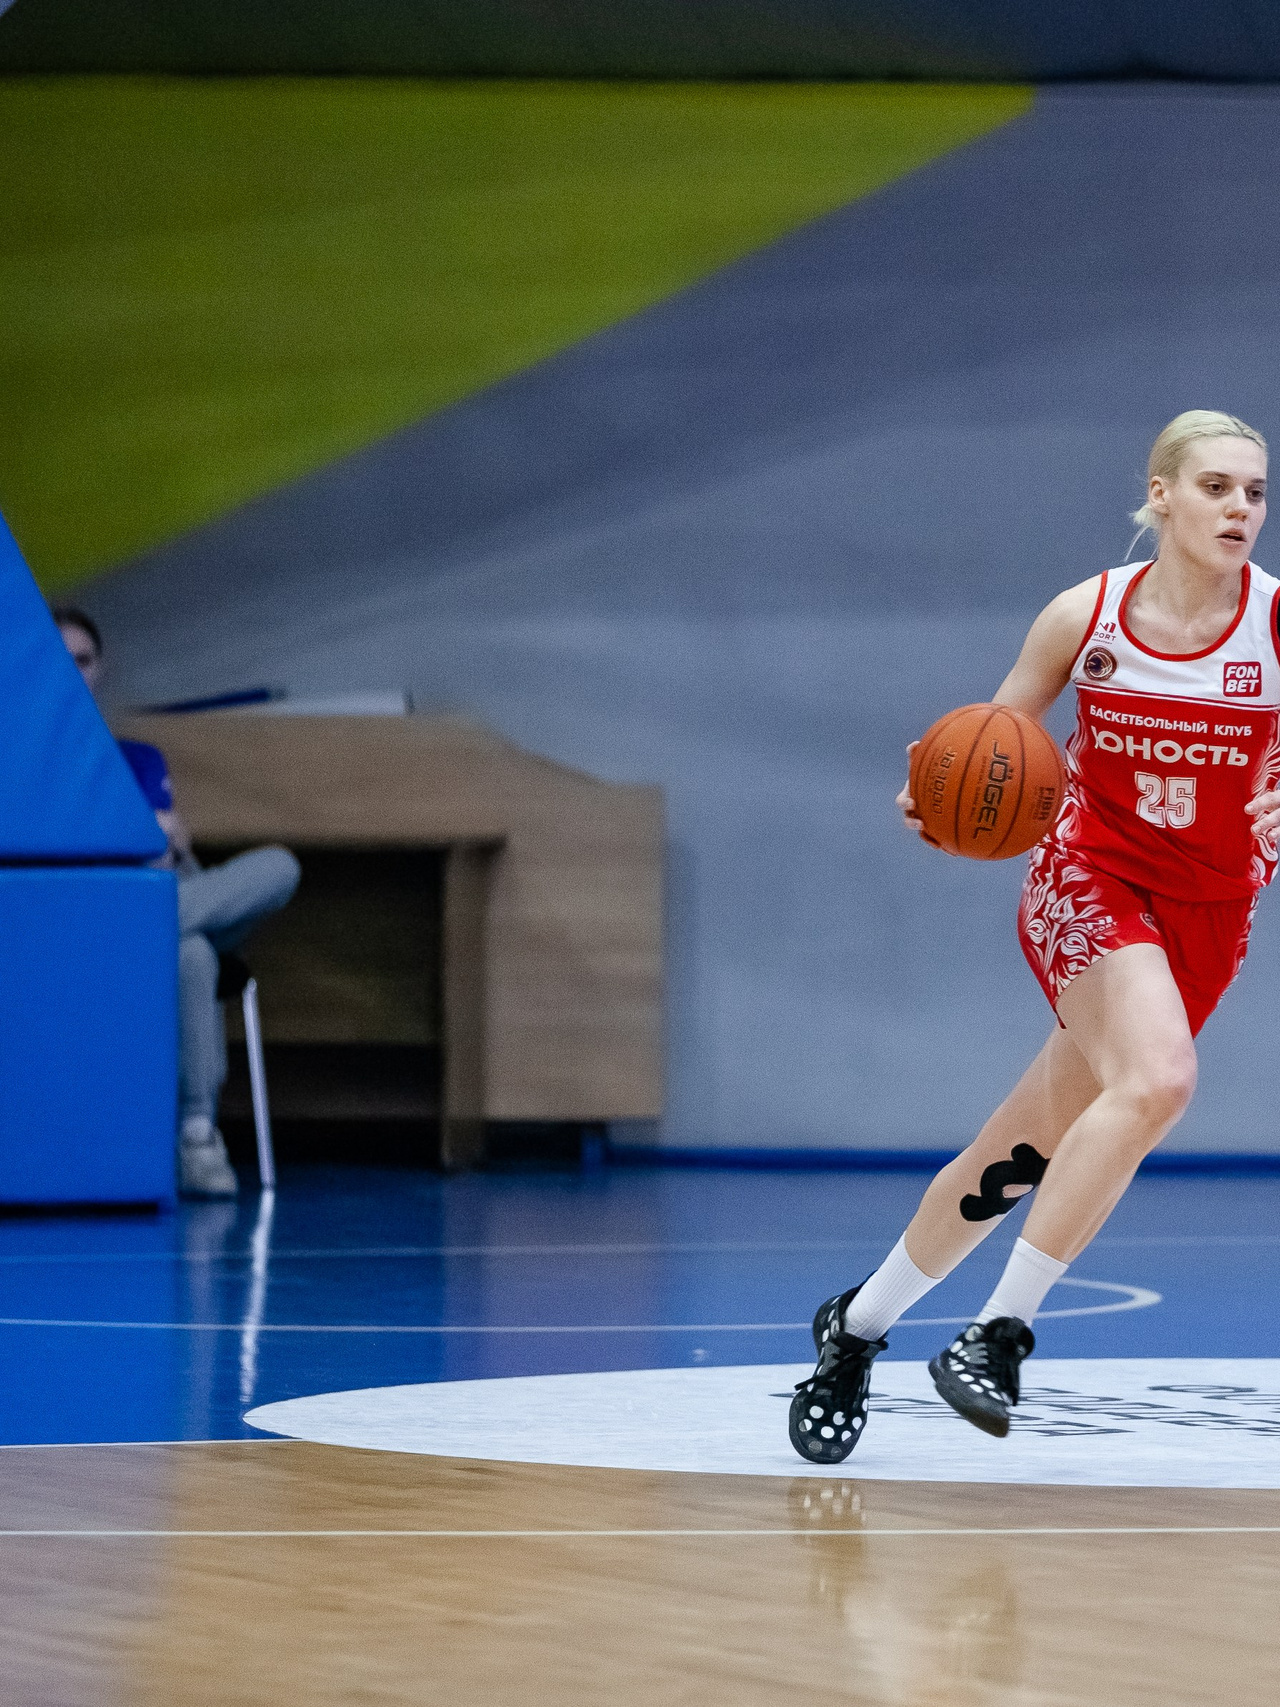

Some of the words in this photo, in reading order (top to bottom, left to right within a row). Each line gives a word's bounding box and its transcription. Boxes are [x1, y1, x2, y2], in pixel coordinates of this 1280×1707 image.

[1094, 632, 1116, 641] PORT
[1225, 665, 1258, 679] FON
[1225, 680, 1259, 693] BET
[1089, 704, 1208, 734] БАСКЕТБОЛЬНЫЙ
[1214, 724, 1252, 737] КЛУБ
[1090, 725, 1249, 767] ЮНОСТЬ
[972, 739, 1014, 840] JÖGEL
[1134, 771, 1197, 829] 25
